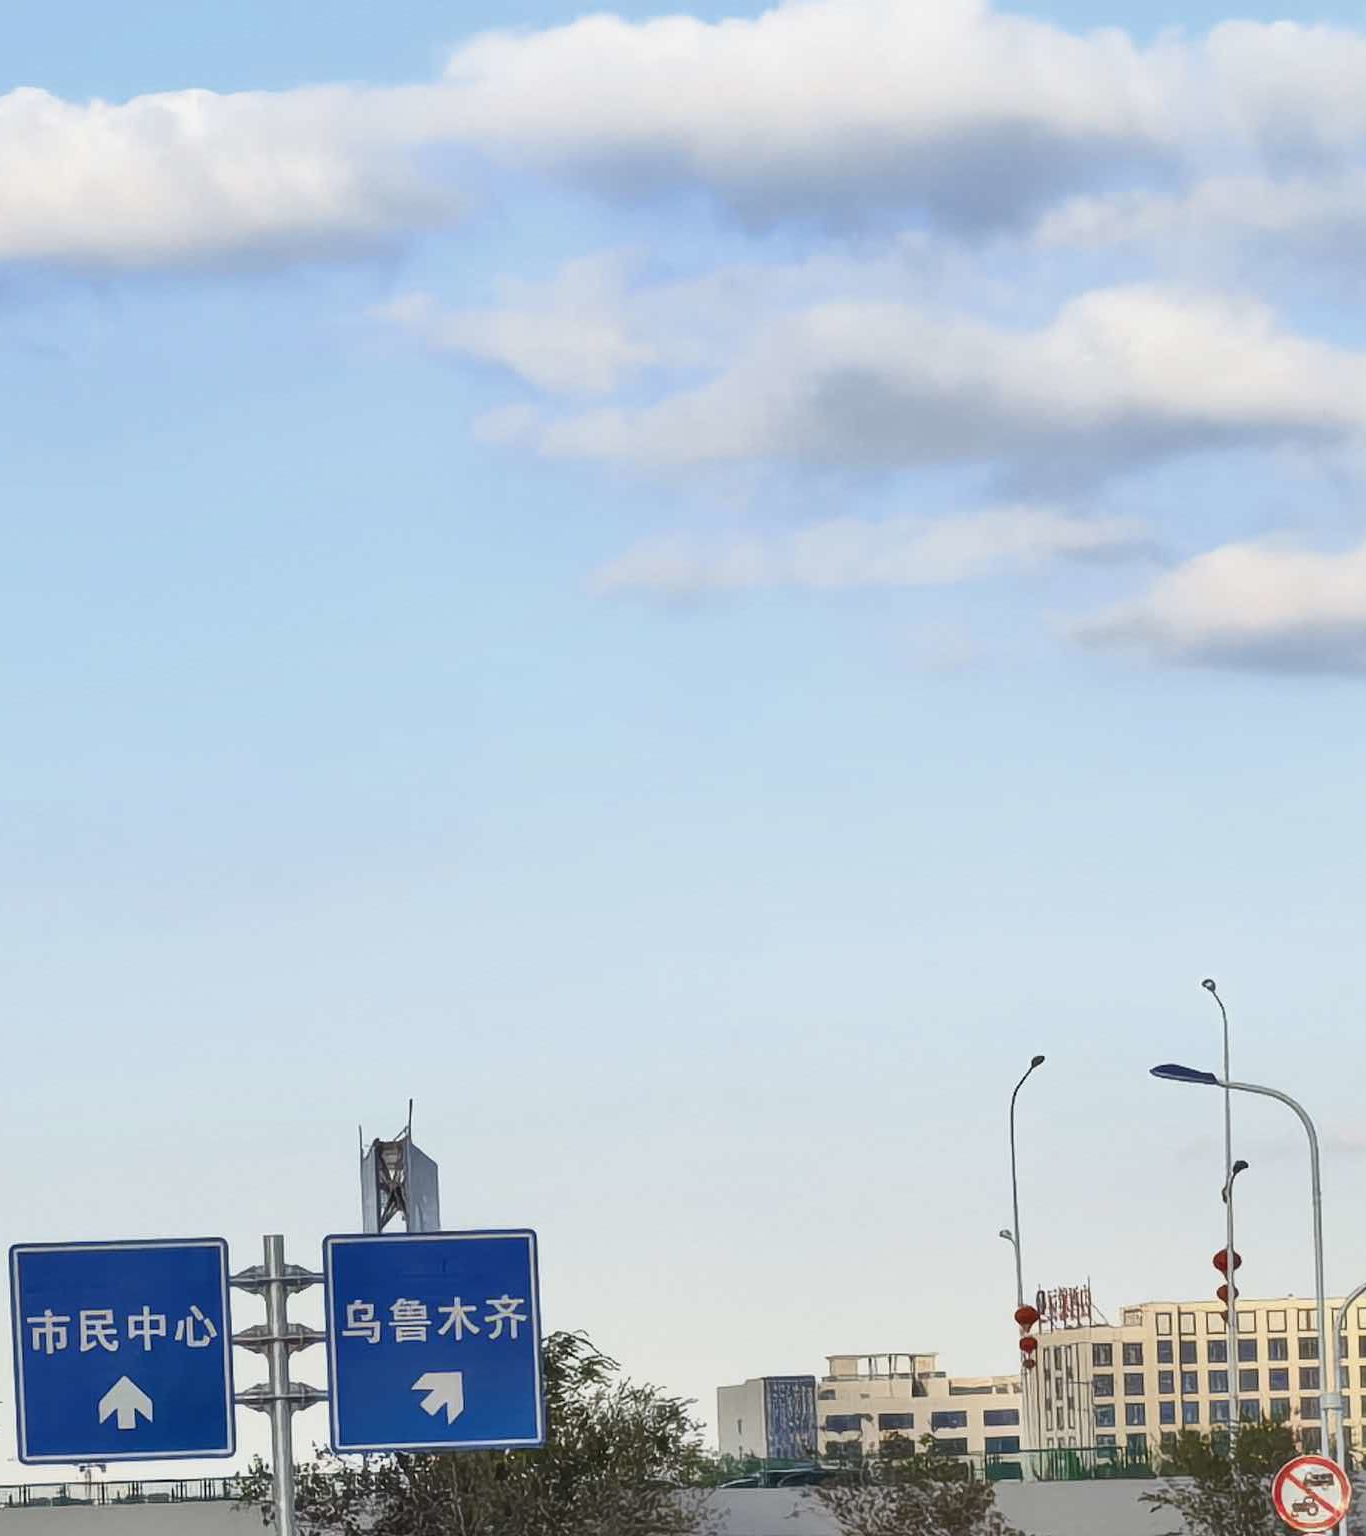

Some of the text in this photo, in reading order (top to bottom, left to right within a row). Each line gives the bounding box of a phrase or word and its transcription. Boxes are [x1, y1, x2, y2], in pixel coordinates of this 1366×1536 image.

[26, 1304, 218, 1355] 市民中心
[341, 1293, 528, 1344] 乌鲁木齐
